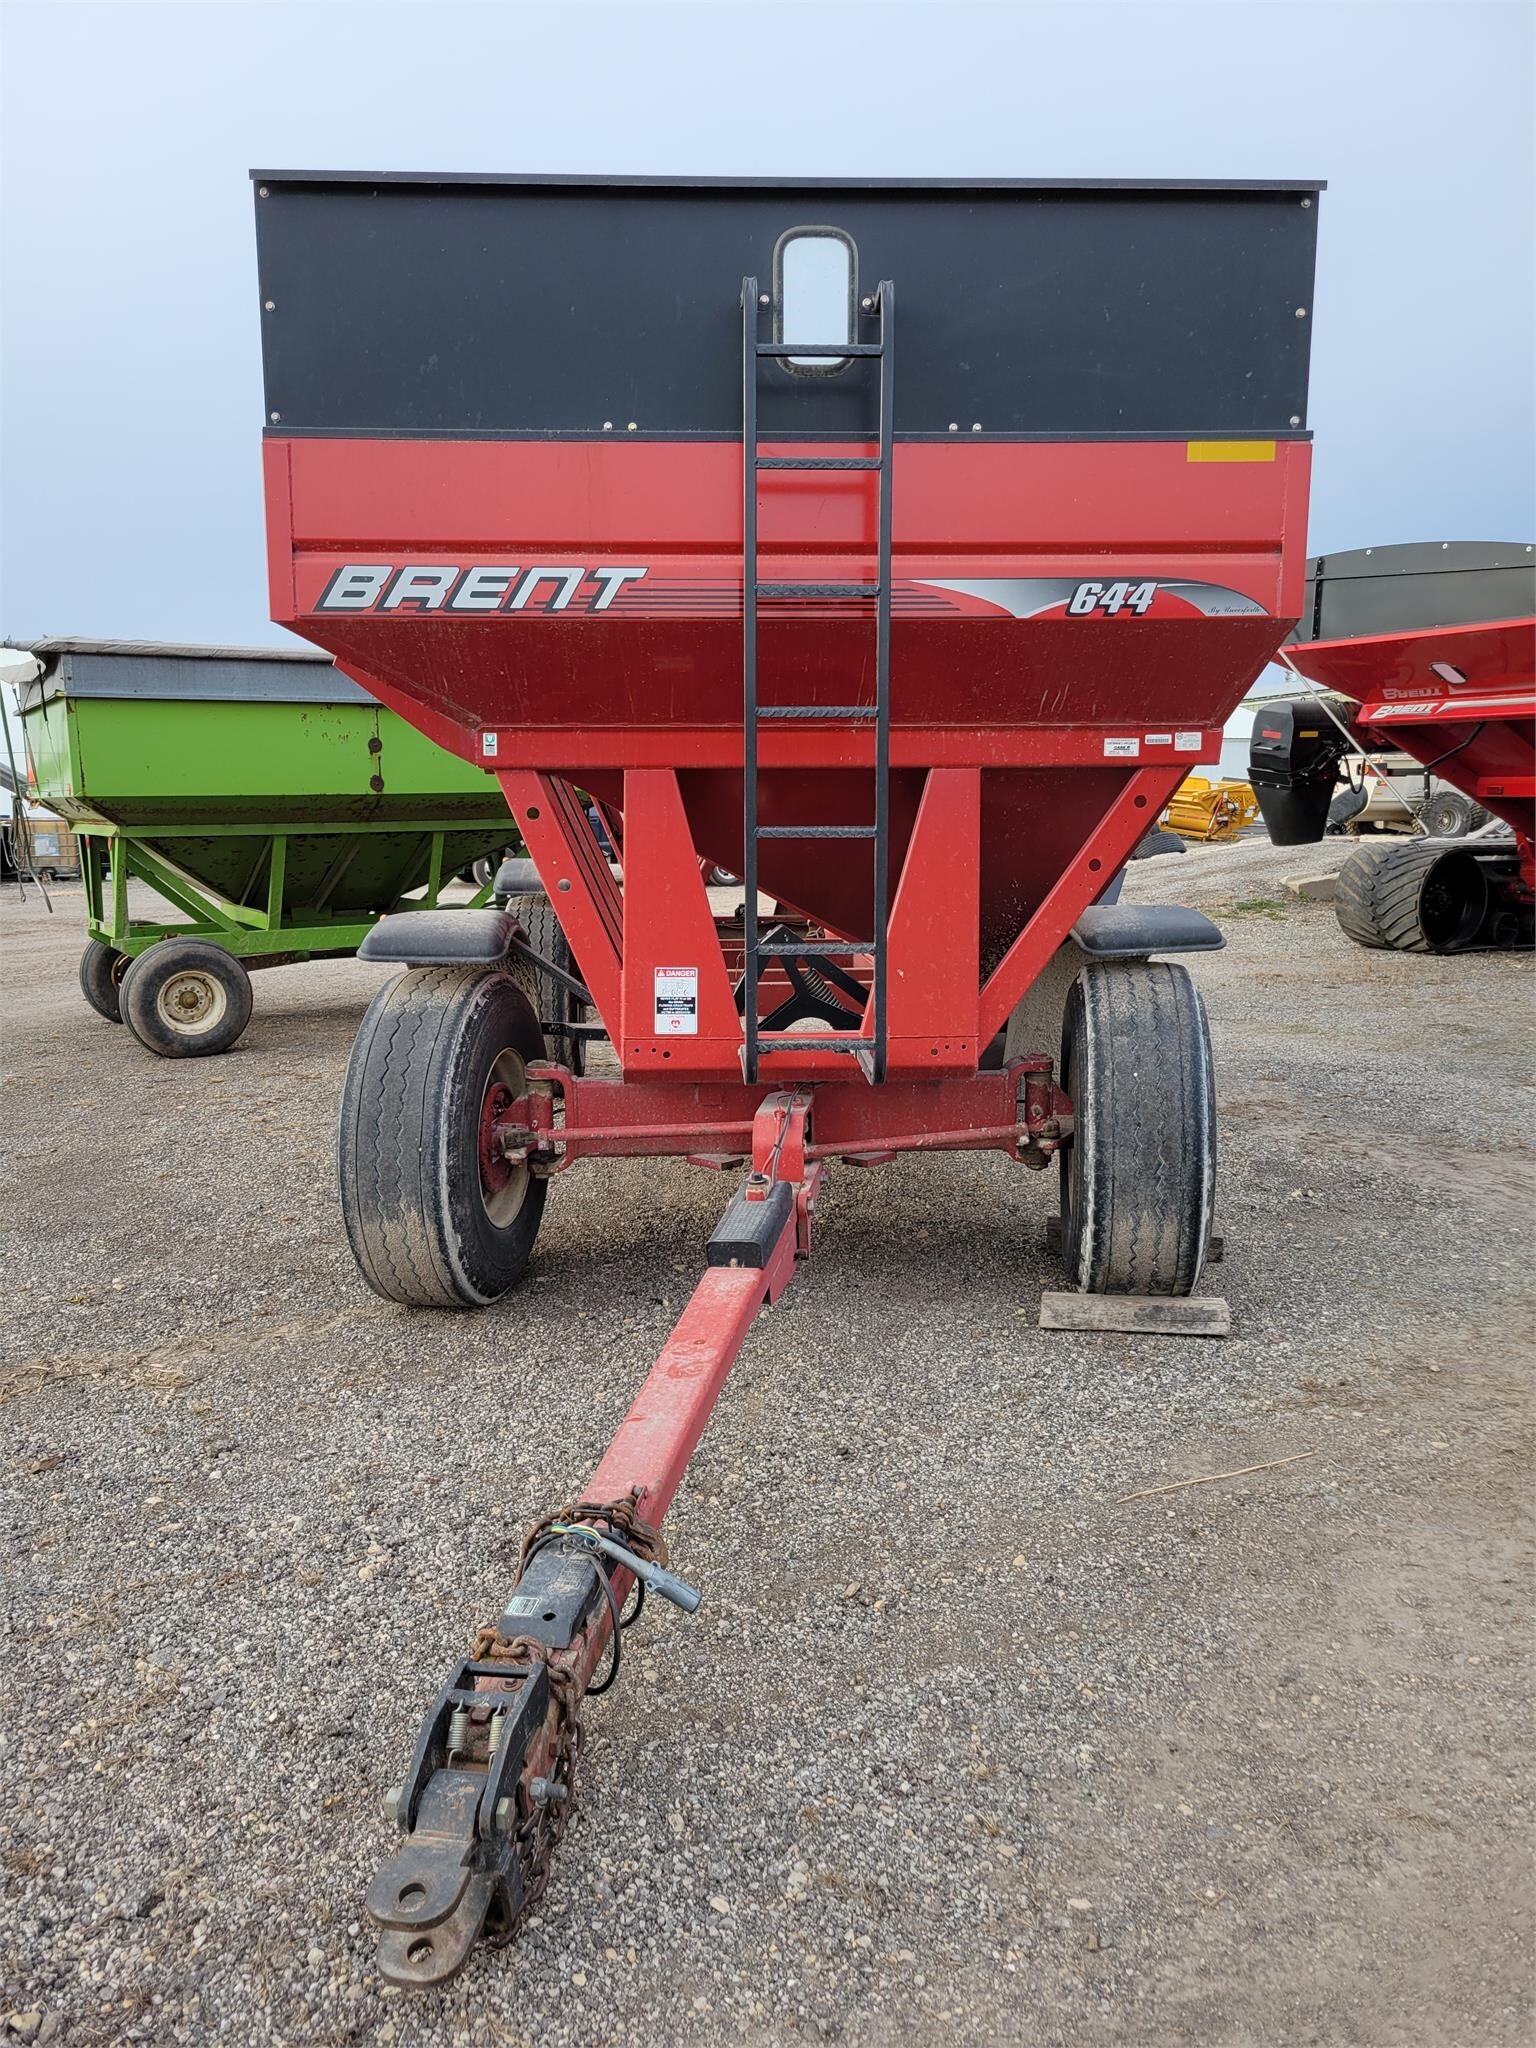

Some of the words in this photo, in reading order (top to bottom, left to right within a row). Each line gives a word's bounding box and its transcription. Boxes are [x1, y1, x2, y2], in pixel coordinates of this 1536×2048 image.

[315, 565, 649, 612] BRENT
[1066, 582, 1157, 616] 644
[1368, 702, 1439, 719] BRENT
